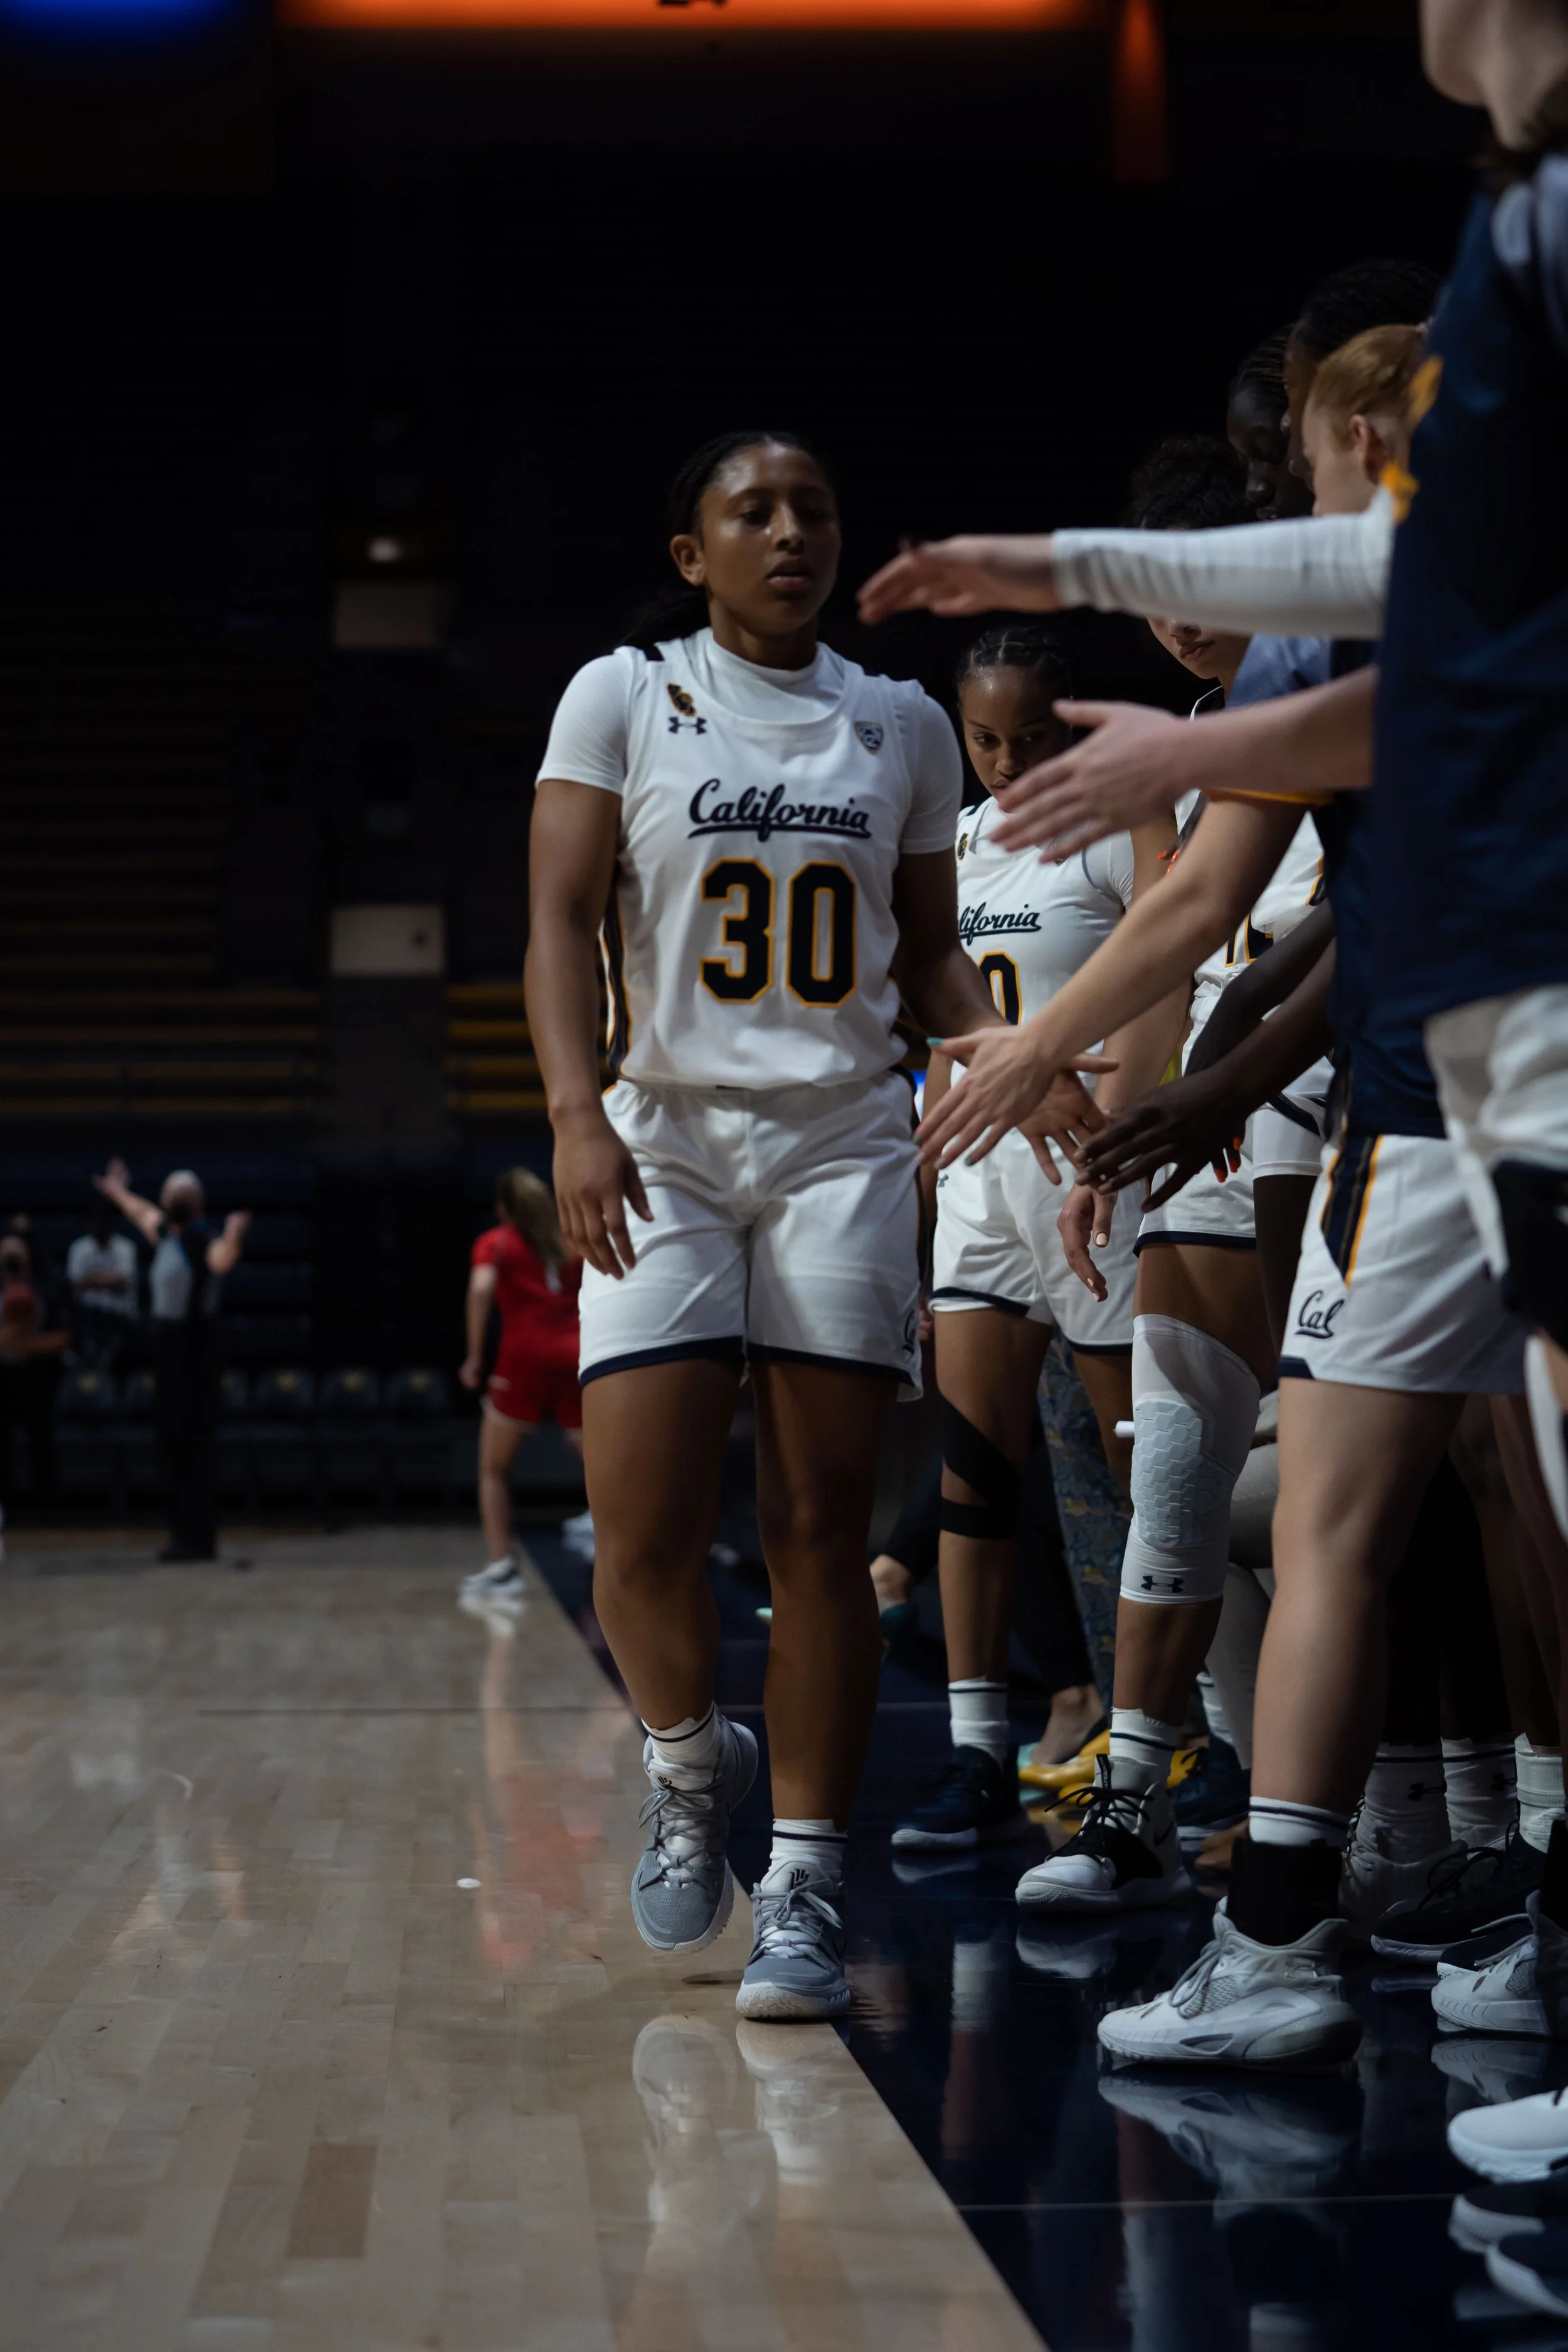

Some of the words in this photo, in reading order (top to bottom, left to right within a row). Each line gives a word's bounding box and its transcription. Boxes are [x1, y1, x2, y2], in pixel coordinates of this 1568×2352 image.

[688, 778, 872, 842] California
[700, 857, 857, 1008] 30
[959, 901, 1042, 946] lifornia
[968, 951, 1022, 1027] 0
[1294, 1290, 1344, 1339] Cal
